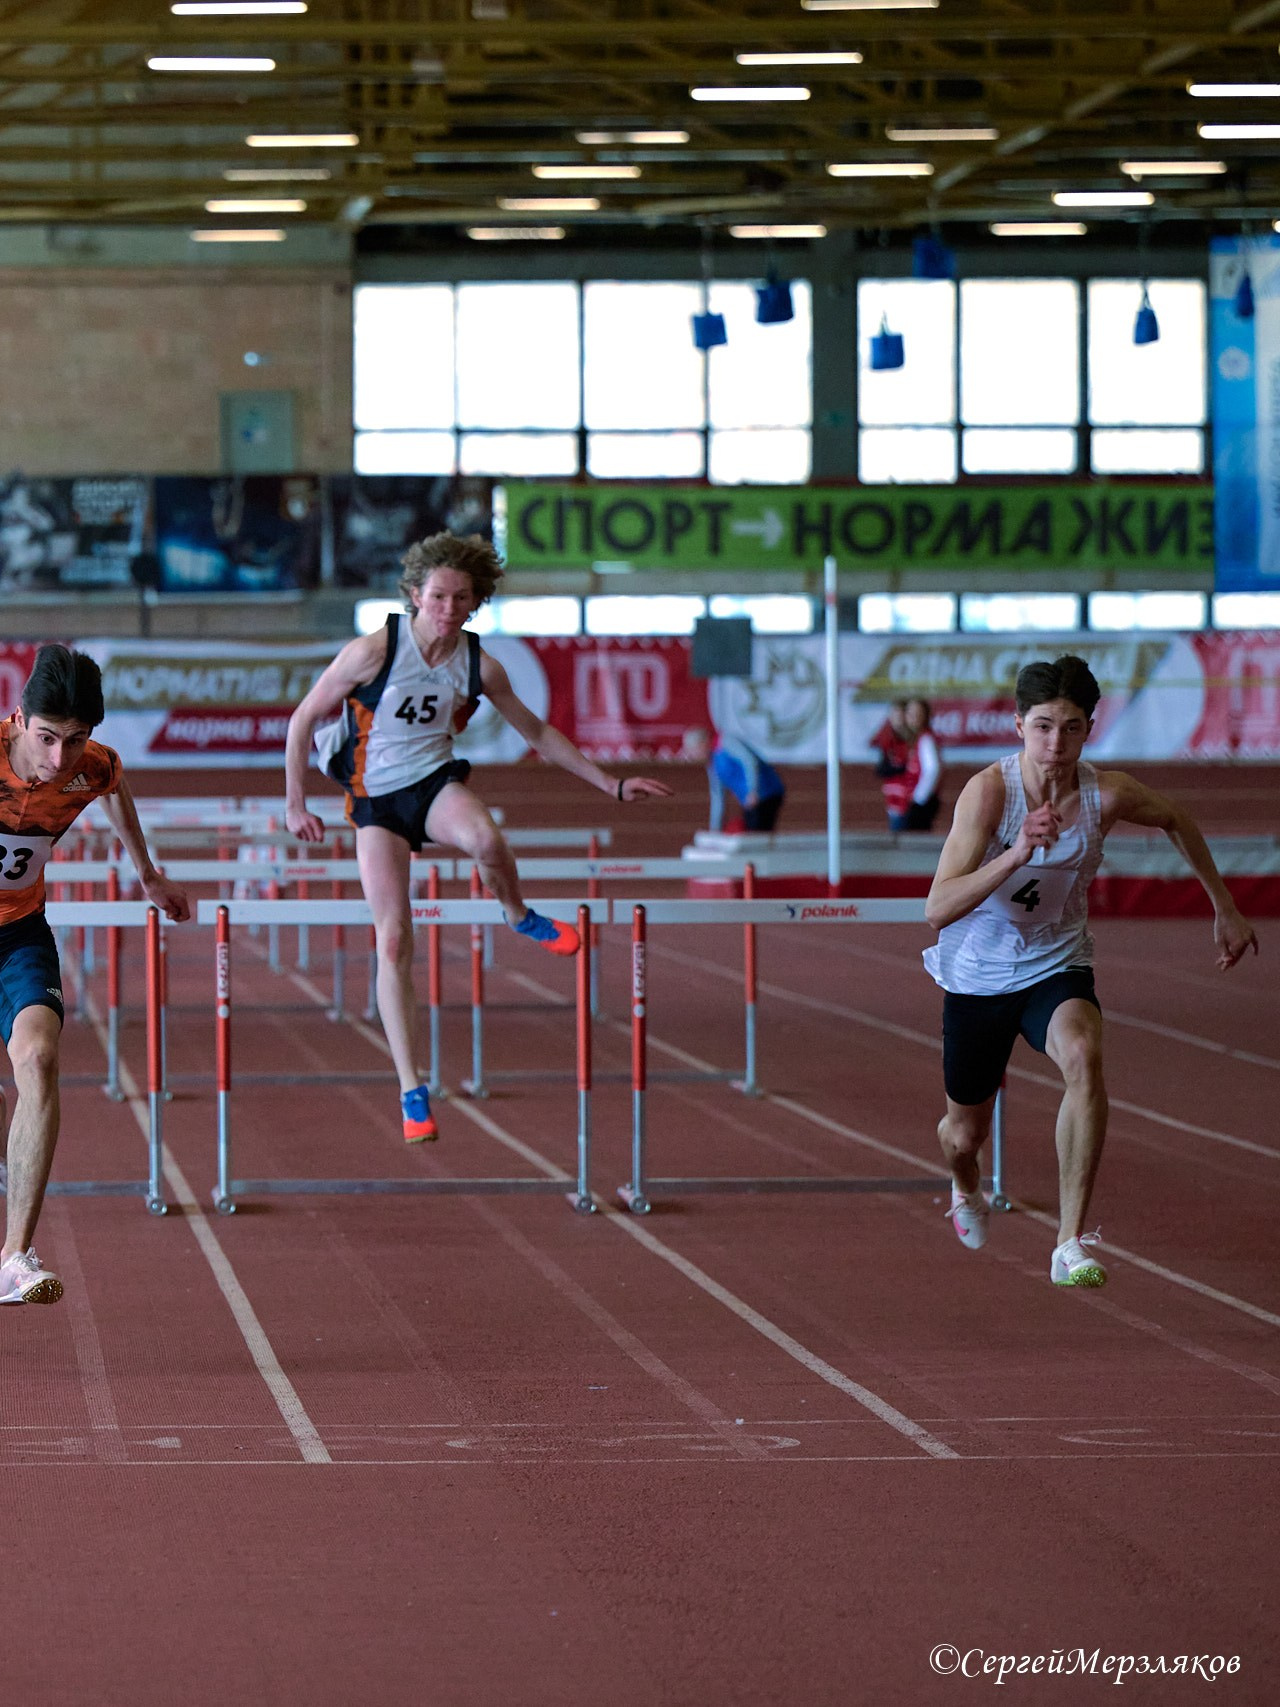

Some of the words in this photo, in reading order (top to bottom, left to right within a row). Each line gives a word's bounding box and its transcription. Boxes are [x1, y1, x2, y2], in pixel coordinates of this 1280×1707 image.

[520, 496, 731, 557] СПОРТ
[794, 497, 1053, 557] НОРМА
[395, 695, 438, 724] 45
[62, 783, 92, 792] adidas
[1010, 879, 1041, 912] 4
[801, 904, 858, 920] polanik
